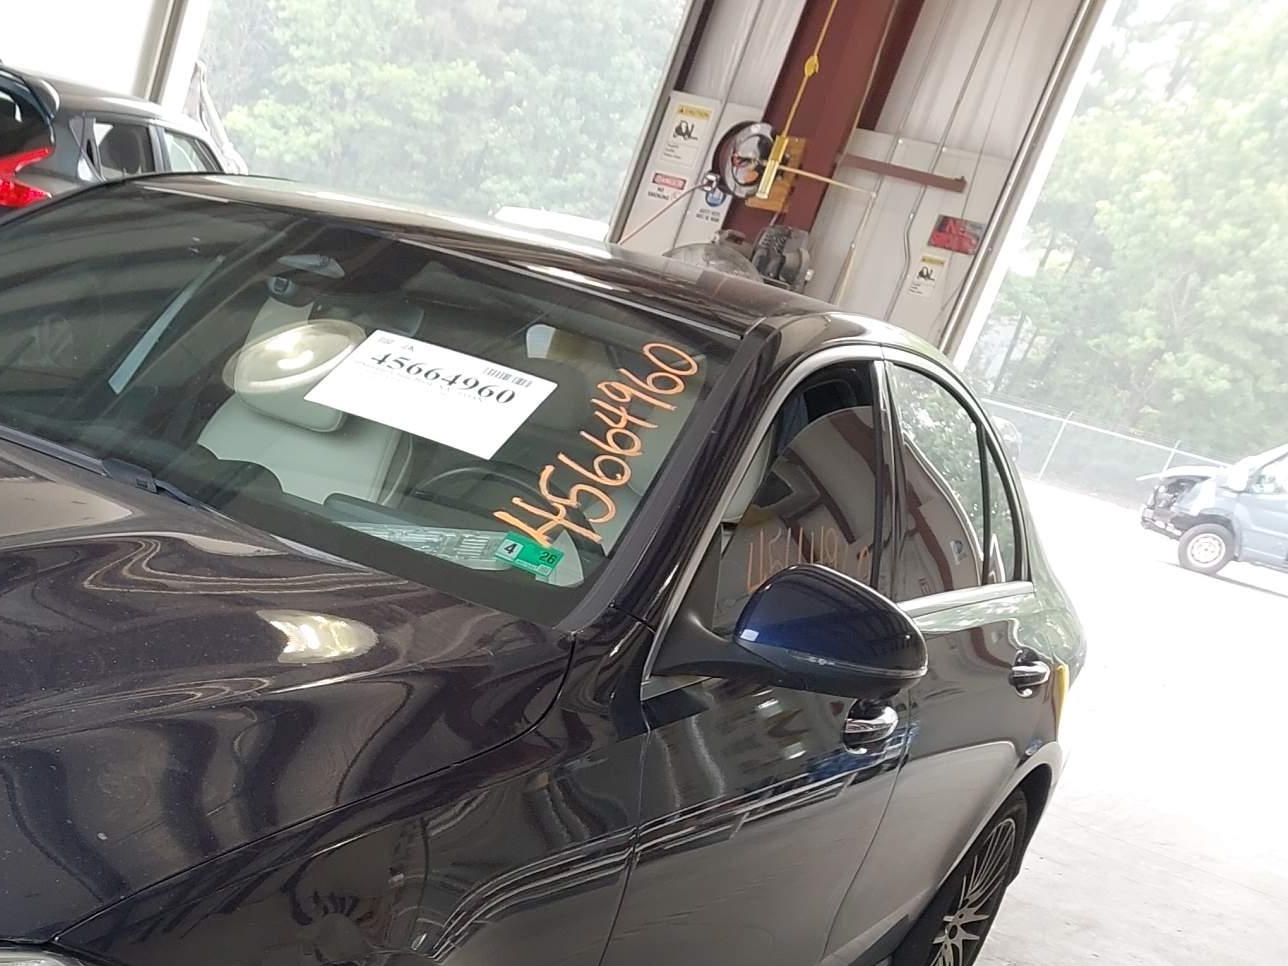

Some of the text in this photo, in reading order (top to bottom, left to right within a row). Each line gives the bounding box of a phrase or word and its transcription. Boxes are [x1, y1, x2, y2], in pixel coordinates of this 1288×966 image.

[371, 353, 516, 404] 45664960
[493, 343, 698, 547] 45664960
[504, 543, 558, 564] 4 26
